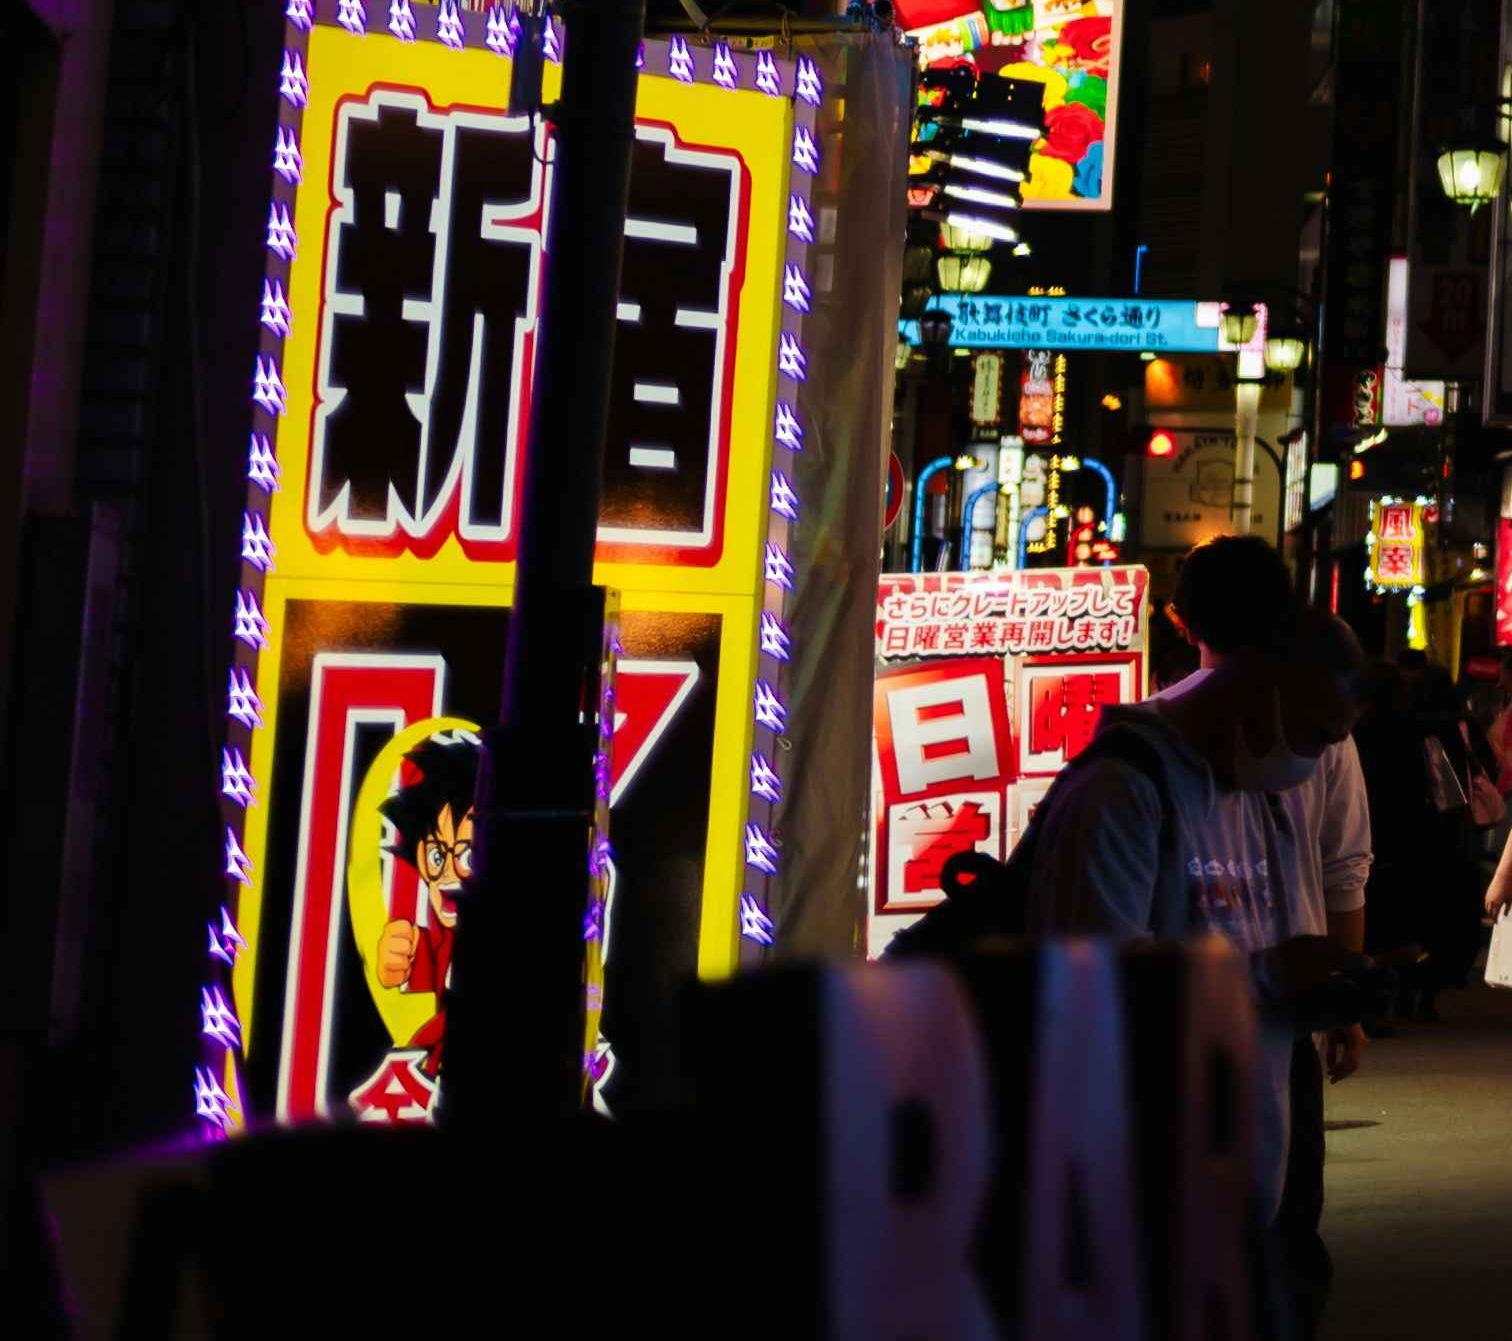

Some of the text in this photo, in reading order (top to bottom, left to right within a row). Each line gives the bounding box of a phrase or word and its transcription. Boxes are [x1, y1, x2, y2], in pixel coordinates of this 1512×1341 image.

[957, 302, 1162, 328] 歌舞伎町 さくら通り
[1146, 332, 1168, 345] St.
